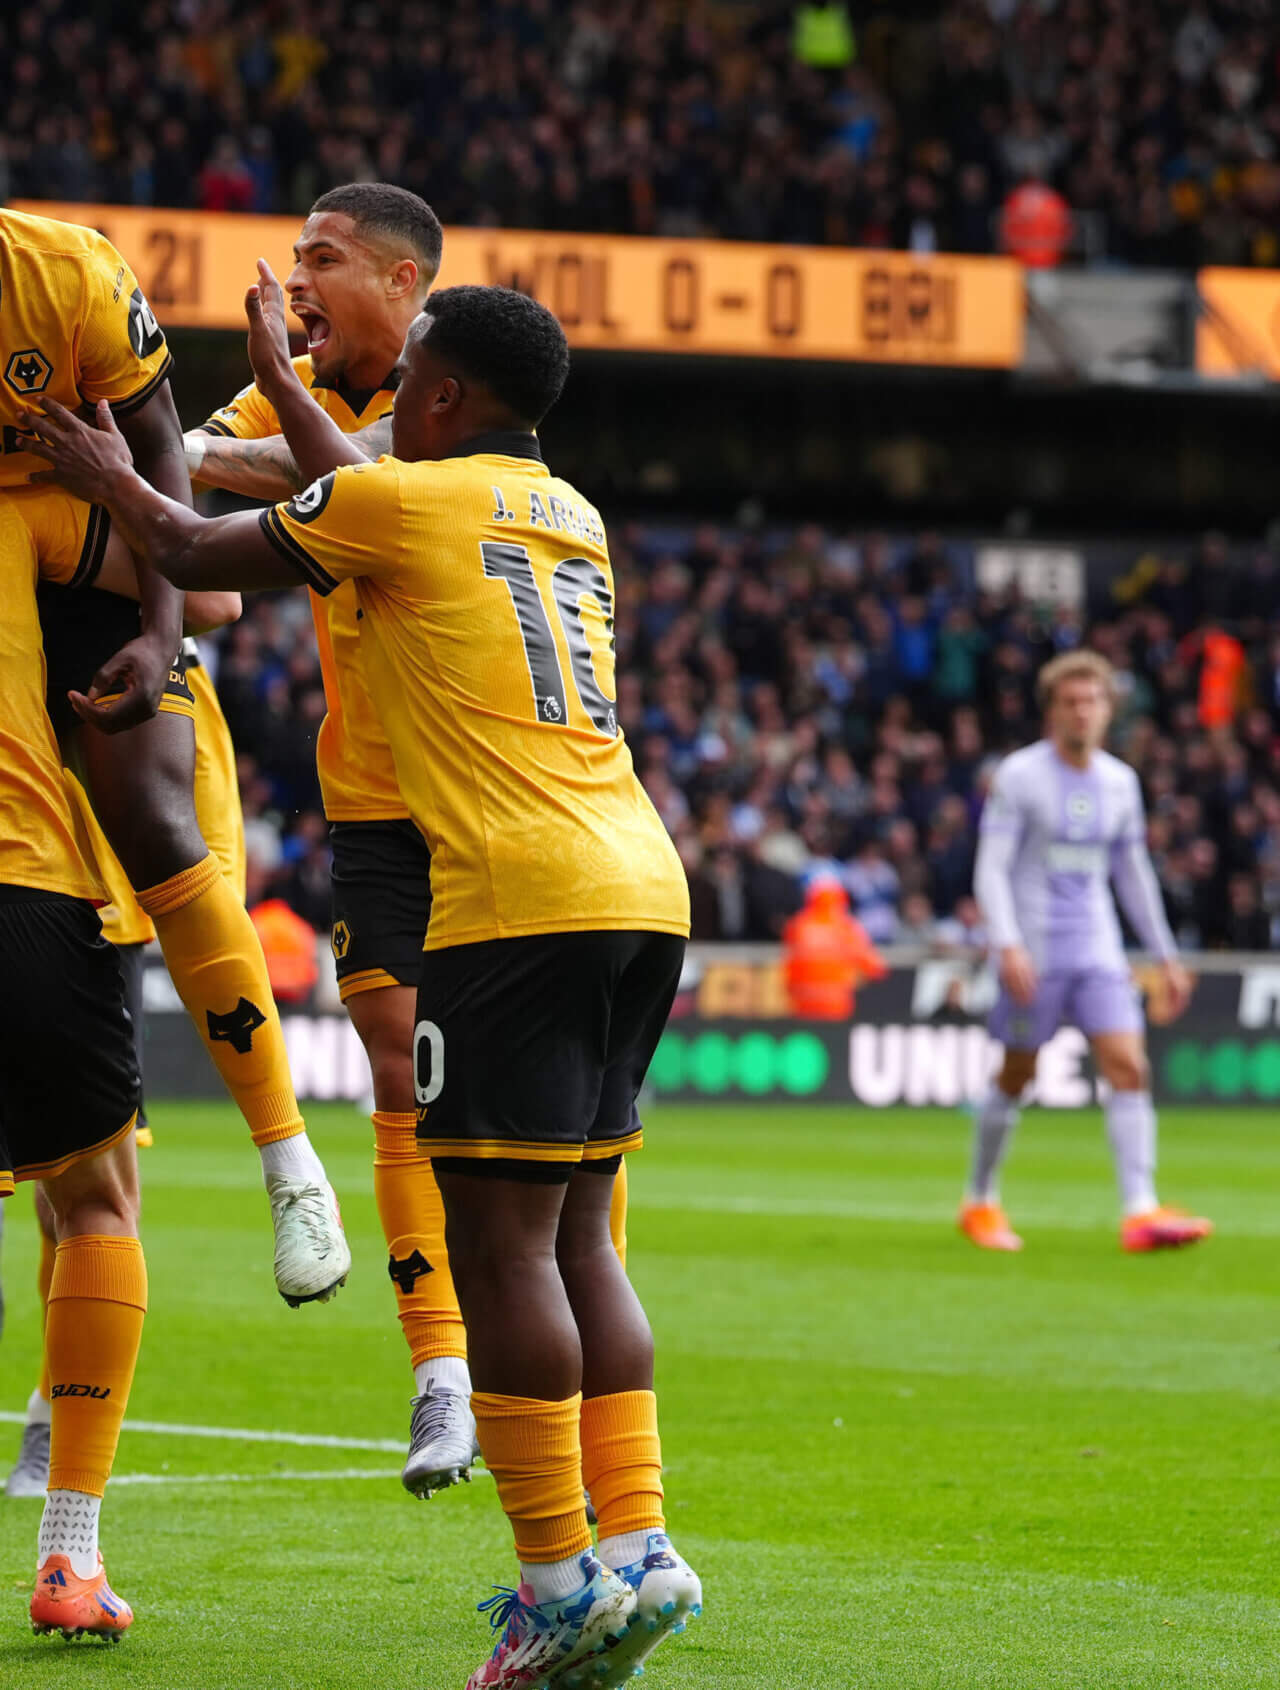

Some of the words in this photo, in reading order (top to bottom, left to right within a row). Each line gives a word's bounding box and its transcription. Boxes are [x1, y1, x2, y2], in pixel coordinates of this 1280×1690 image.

[863, 268, 957, 345] BRI
[491, 486, 515, 521] J.
[529, 492, 604, 546] ARIAS
[479, 541, 617, 739] 10
[51, 1383, 111, 1400] SUDU
